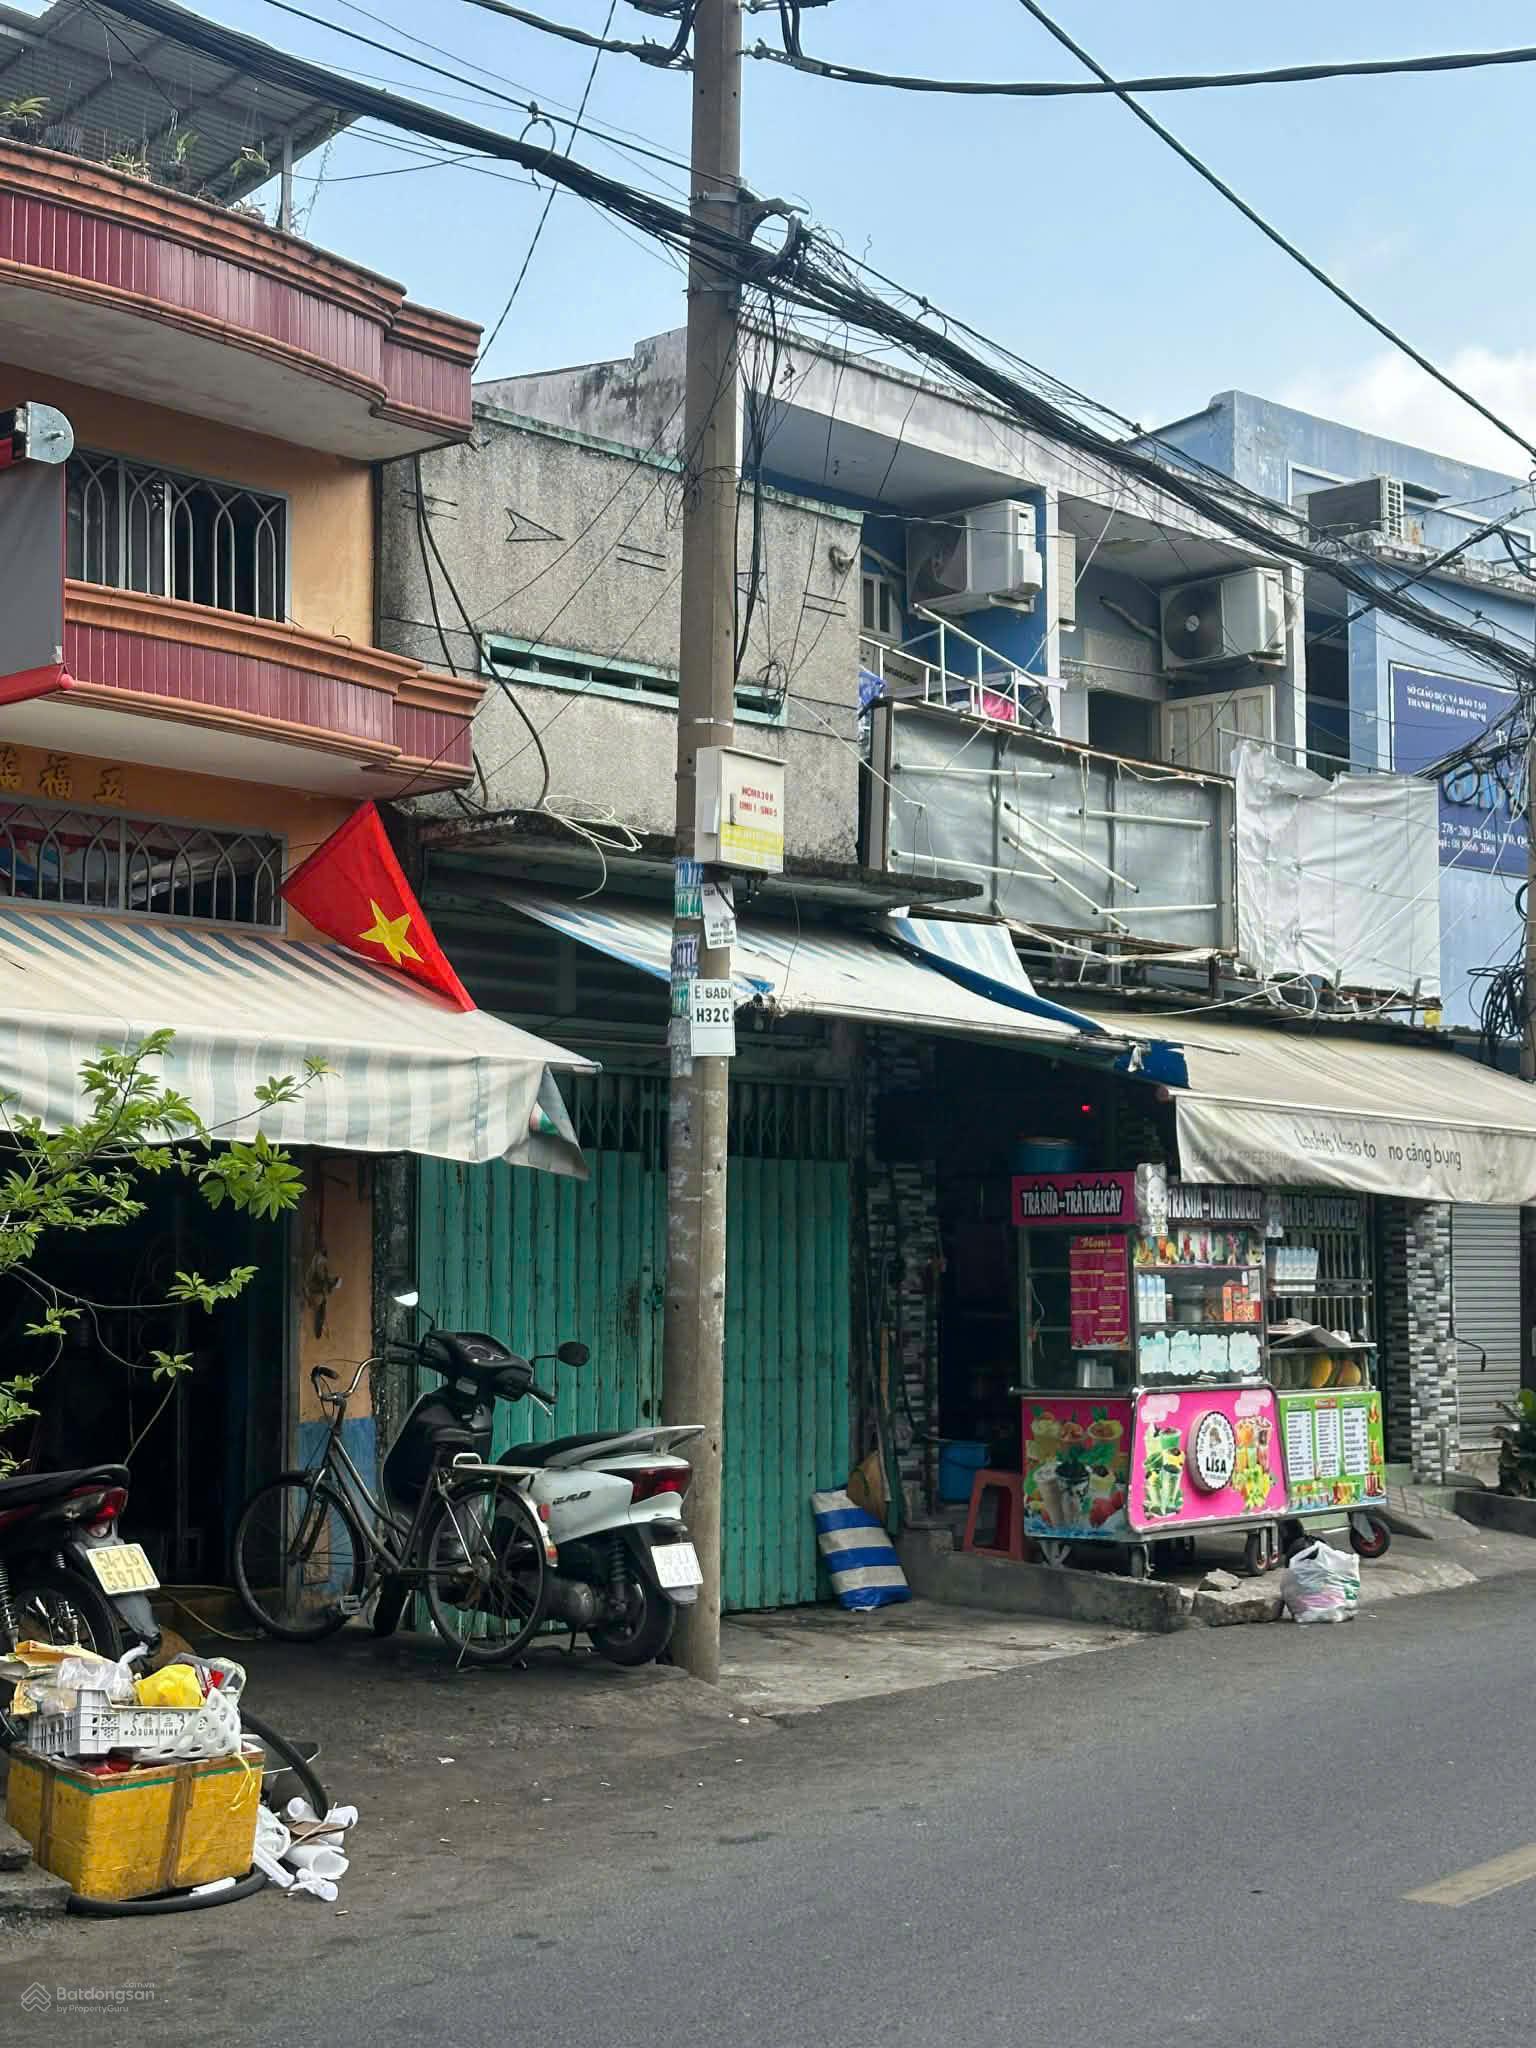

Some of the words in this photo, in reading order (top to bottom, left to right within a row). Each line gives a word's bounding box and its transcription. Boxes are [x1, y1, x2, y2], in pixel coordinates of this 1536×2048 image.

[696, 1007, 730, 1023] H32C
[1363, 1138, 1377, 1158] to
[1388, 1145, 1403, 1160] no
[138, 1727, 179, 1737] SUNSHINE
